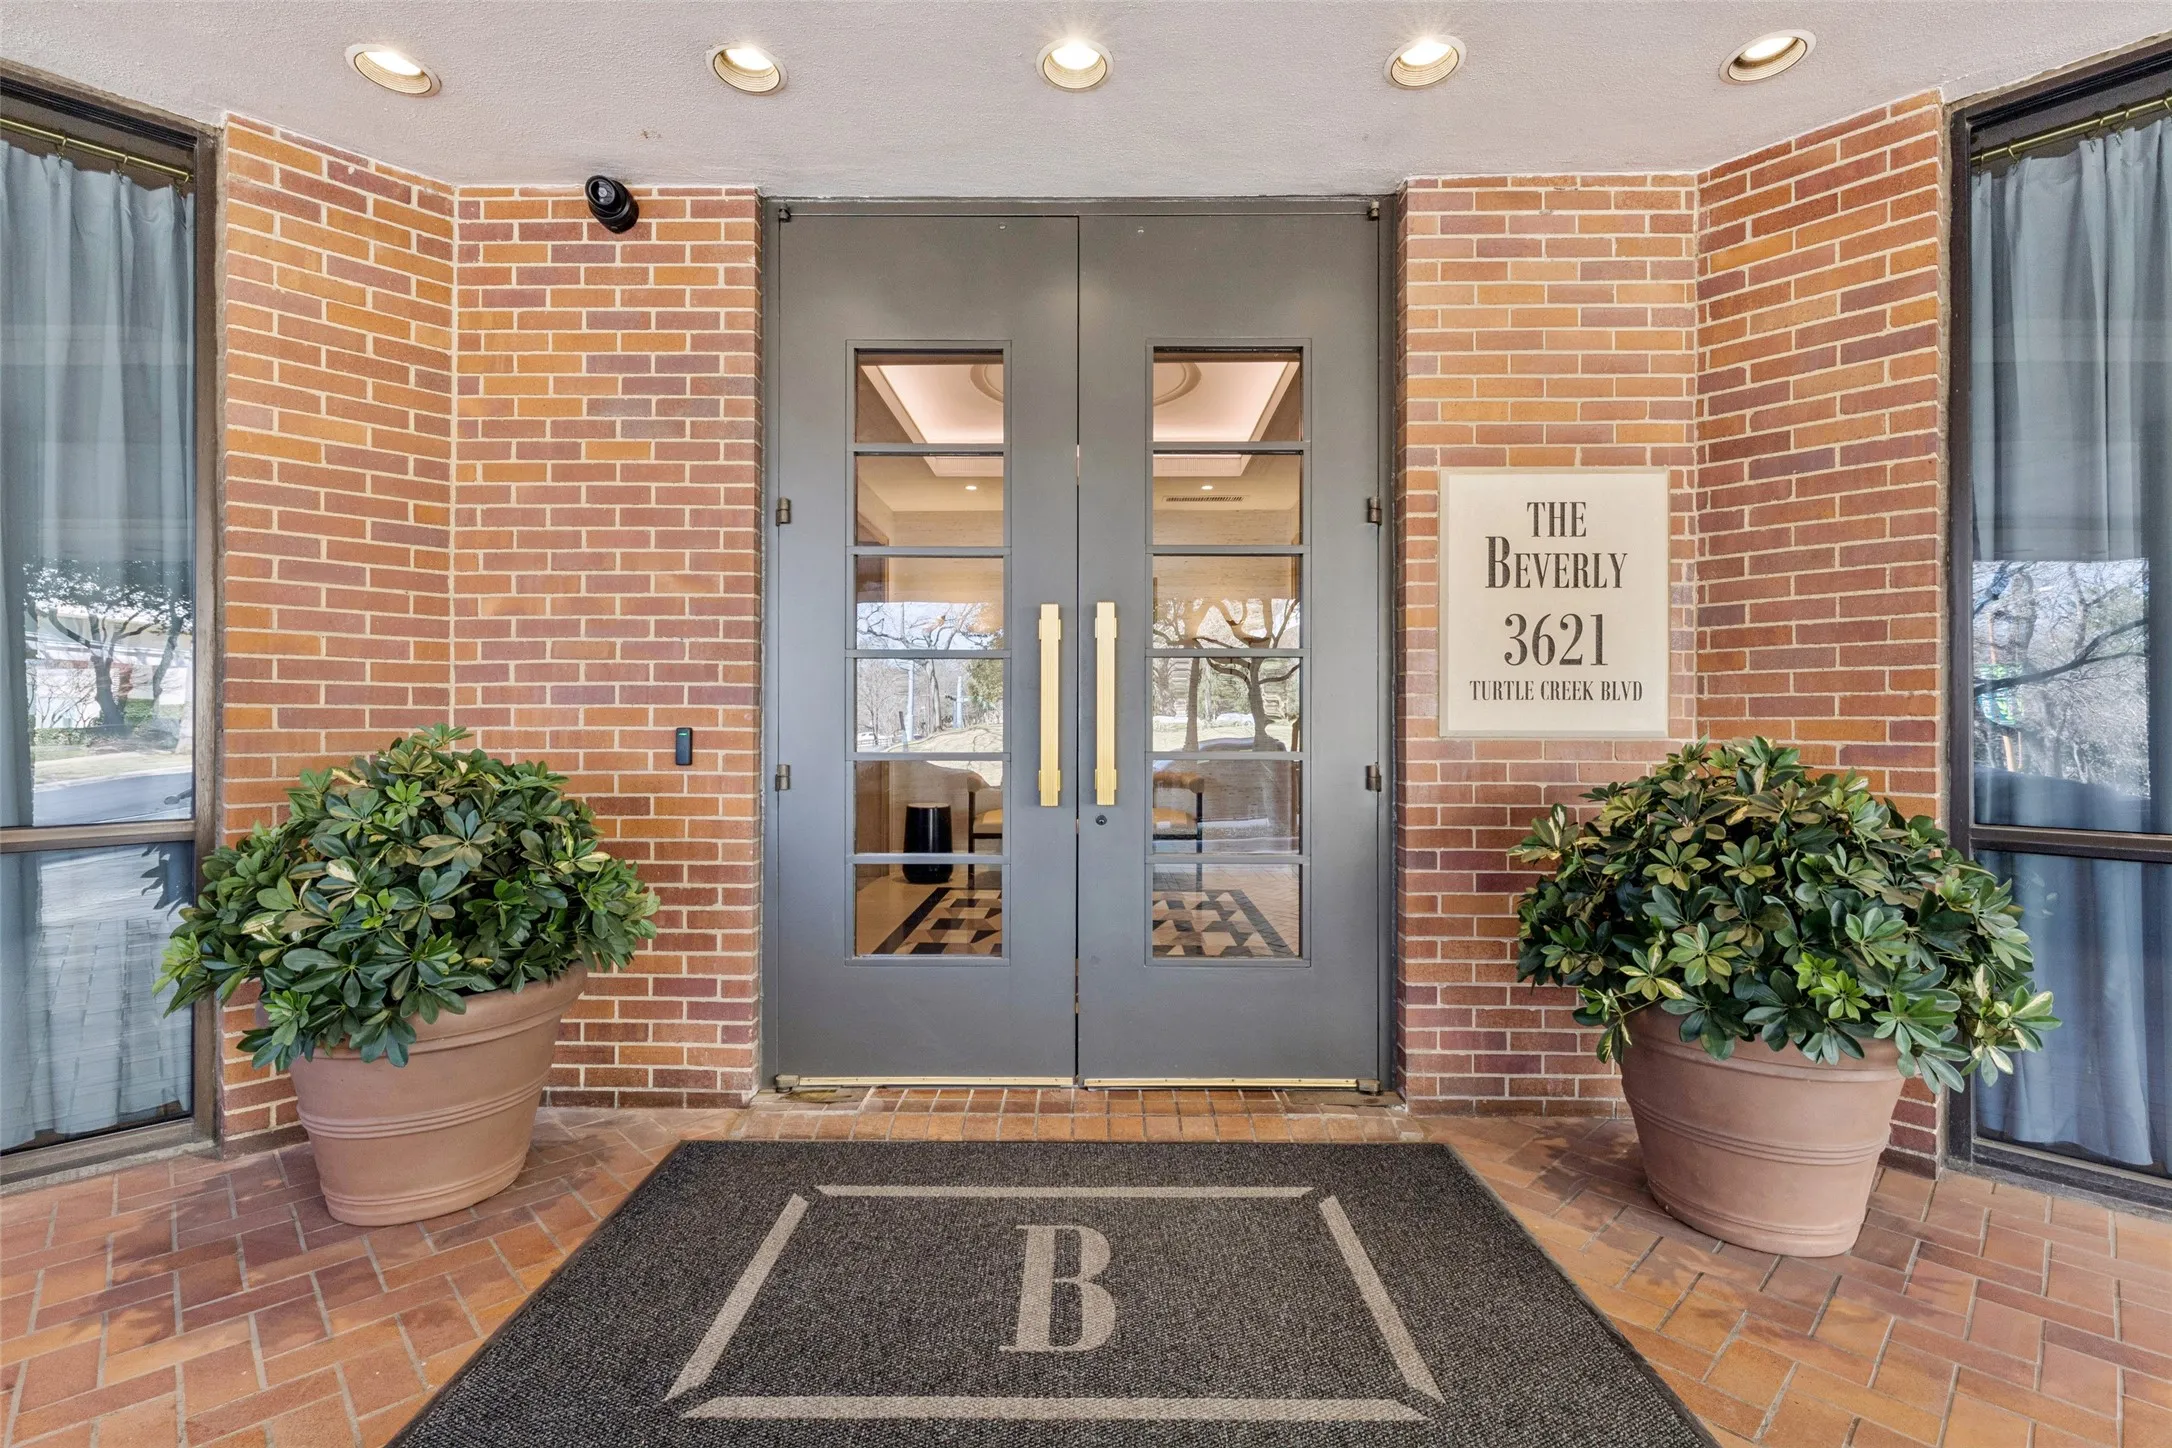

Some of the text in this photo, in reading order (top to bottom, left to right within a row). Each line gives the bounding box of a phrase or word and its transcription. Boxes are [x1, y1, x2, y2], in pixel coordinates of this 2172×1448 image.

[1526, 501, 1587, 538] THE
[1484, 536, 1628, 589] BEVERLY
[1503, 613, 1609, 666] 3621
[1469, 680, 1643, 701] TURTLE CREEK BLVD
[999, 1224, 1117, 1353] B
